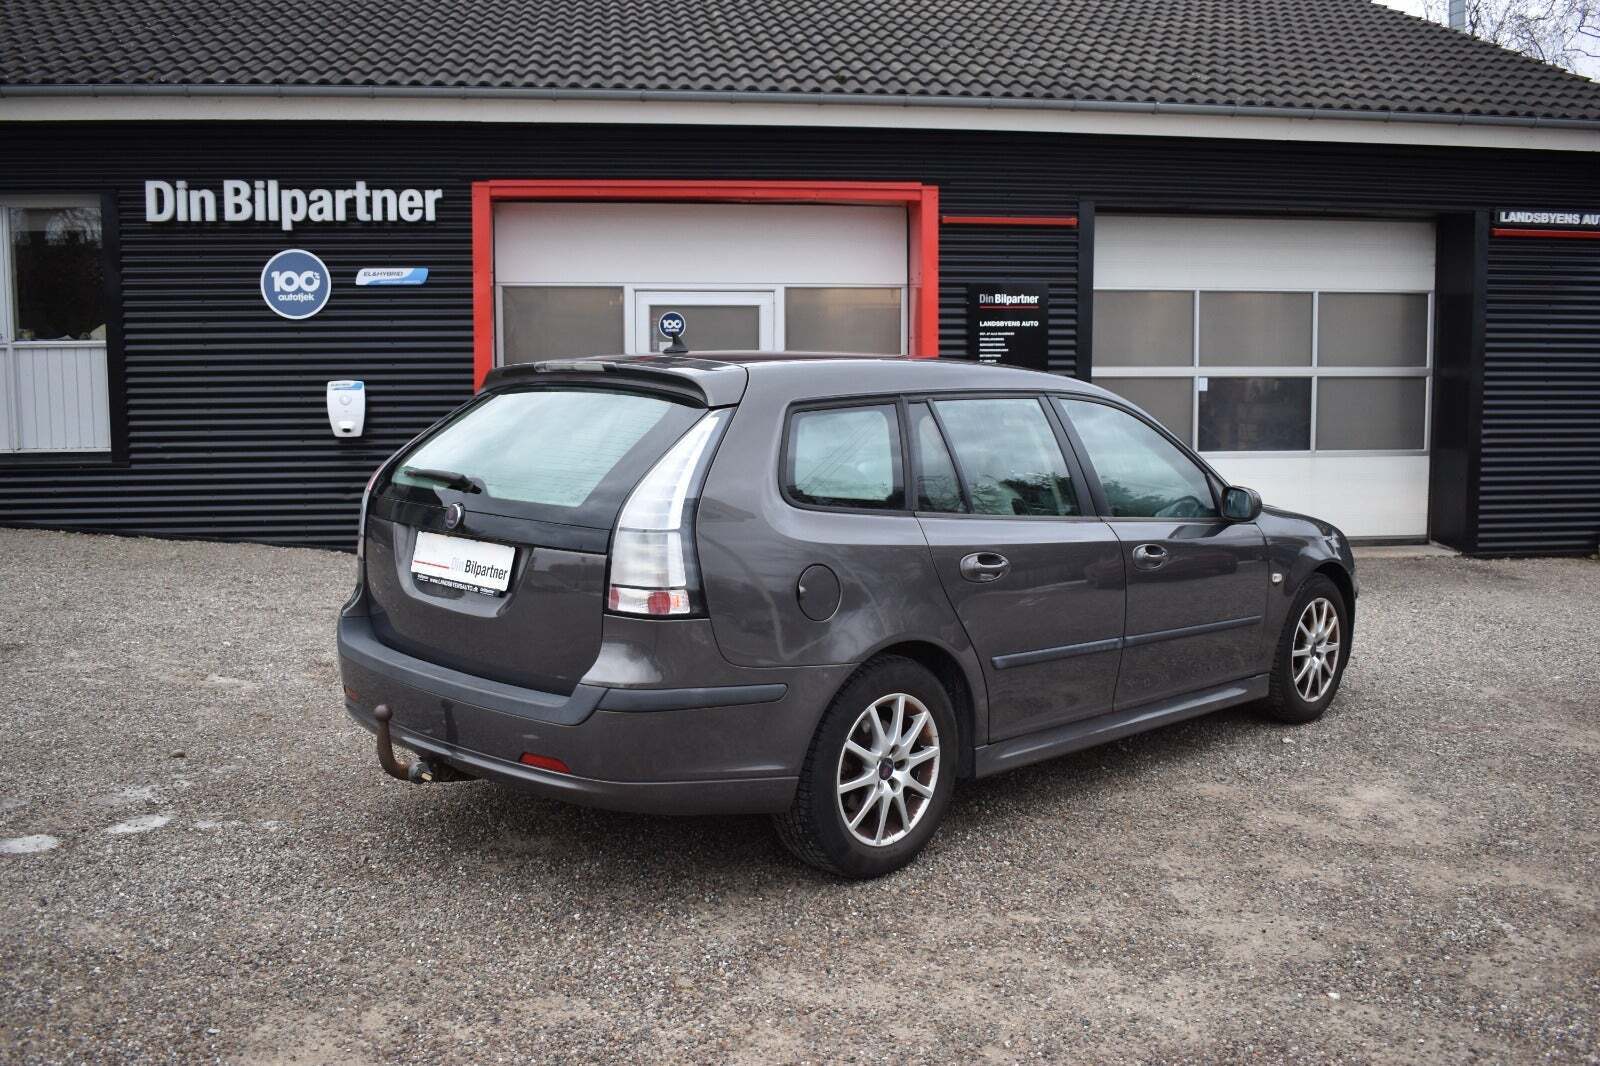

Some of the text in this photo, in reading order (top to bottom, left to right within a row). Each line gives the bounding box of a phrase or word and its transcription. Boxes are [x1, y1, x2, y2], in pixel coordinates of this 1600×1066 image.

[145, 179, 443, 231] Din Bilpartner
[1500, 211, 1600, 225] LANDSBYENS AU
[278, 293, 315, 303] autotjek
[980, 294, 1039, 305] Din Bilpartner
[663, 320, 682, 328] 100
[465, 560, 508, 580] Bilpartner
